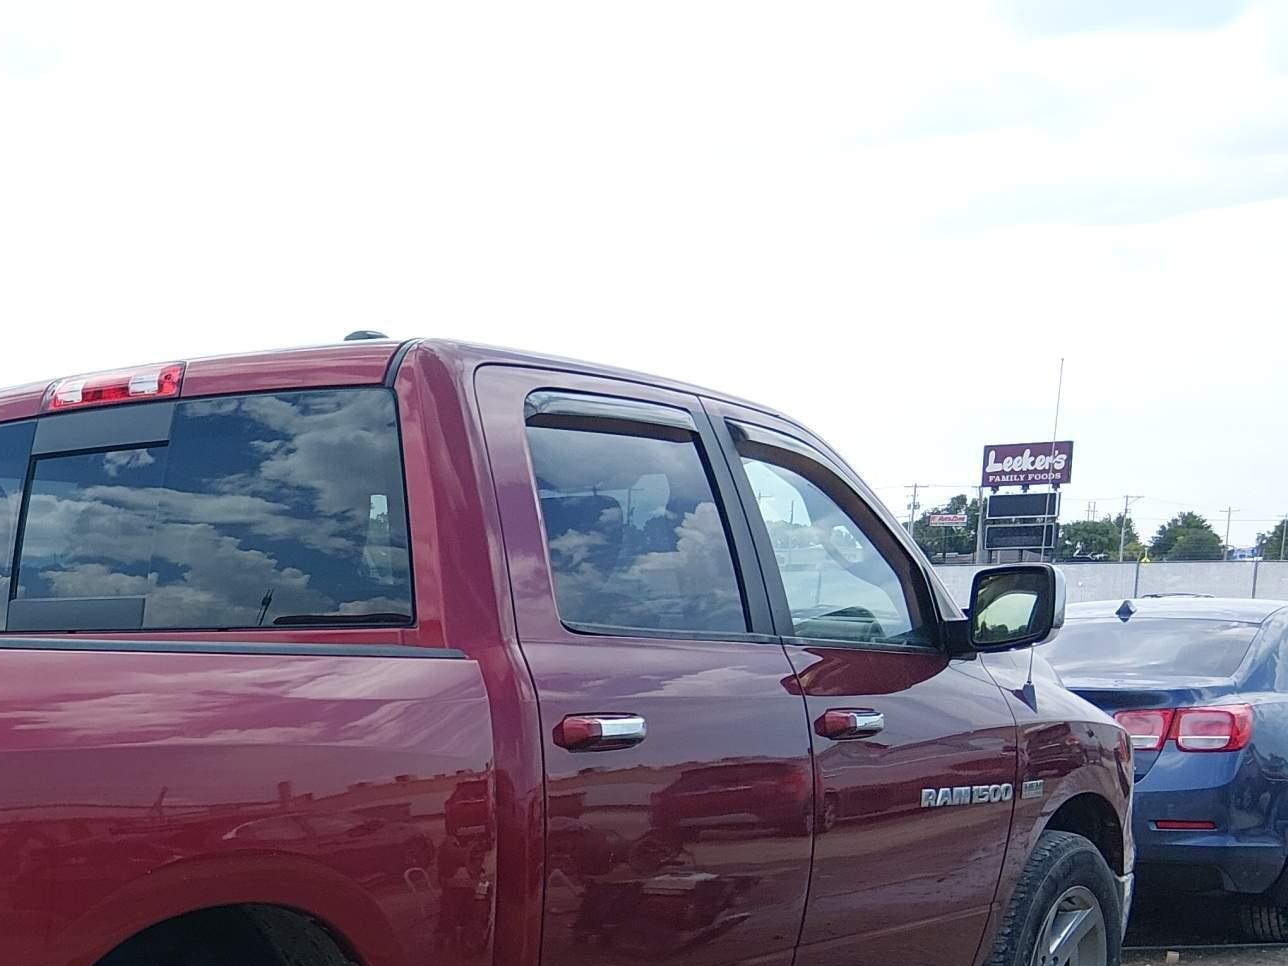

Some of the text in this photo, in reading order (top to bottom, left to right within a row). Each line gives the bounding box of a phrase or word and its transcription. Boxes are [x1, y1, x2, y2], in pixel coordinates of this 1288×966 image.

[986, 449, 1067, 473] Leeker's
[989, 472, 1061, 482] FAMILY FOODS
[921, 787, 971, 807] RAM
[972, 783, 1013, 803] 1500
